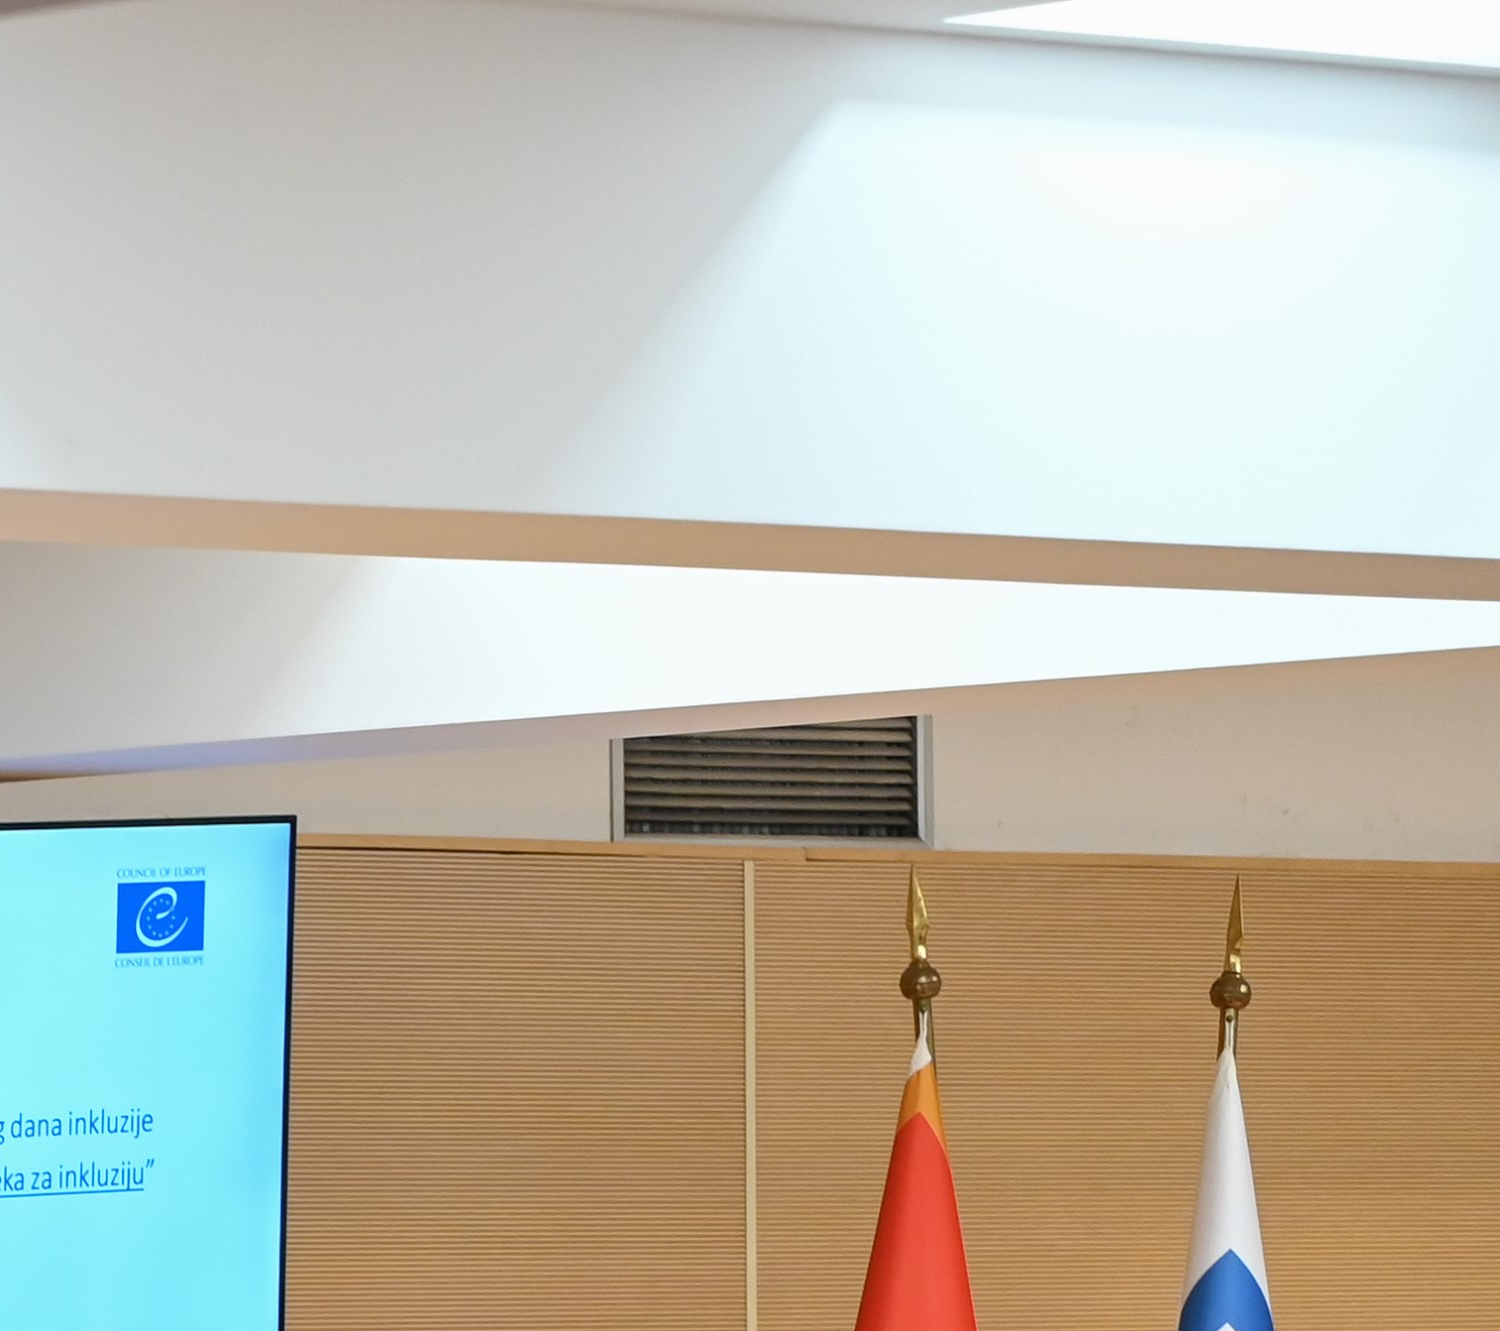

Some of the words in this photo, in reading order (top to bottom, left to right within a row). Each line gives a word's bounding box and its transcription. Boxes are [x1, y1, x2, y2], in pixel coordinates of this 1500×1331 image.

[117, 868, 156, 878] COUNCIL
[160, 867, 170, 877] OF
[175, 866, 206, 876] EUROPE
[115, 958, 150, 968] CONSEIL
[154, 957, 164, 967] DE
[10, 1114, 61, 1140] dana
[68, 1108, 154, 1138] inkluzije
[30, 1168, 52, 1189] za
